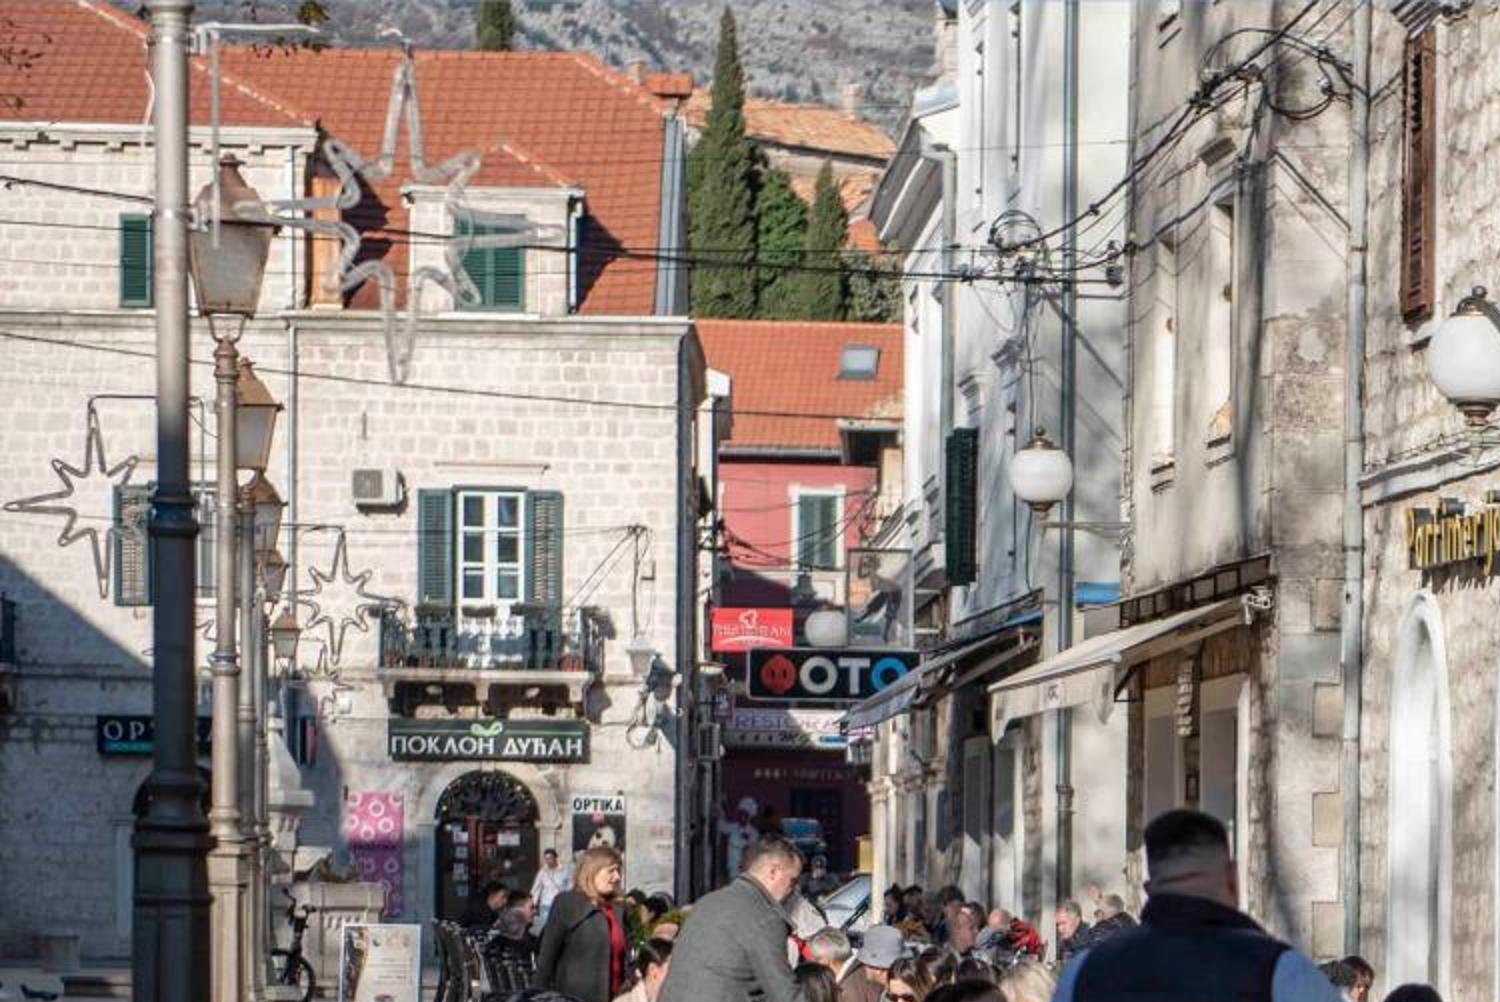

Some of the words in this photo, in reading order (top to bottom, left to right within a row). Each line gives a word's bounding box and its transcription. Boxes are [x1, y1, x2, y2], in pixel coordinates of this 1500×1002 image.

[391, 735, 494, 755] ПОКЛОН
[503, 737, 583, 756] ДУЋАН
[573, 798, 623, 811] OPTIKA
